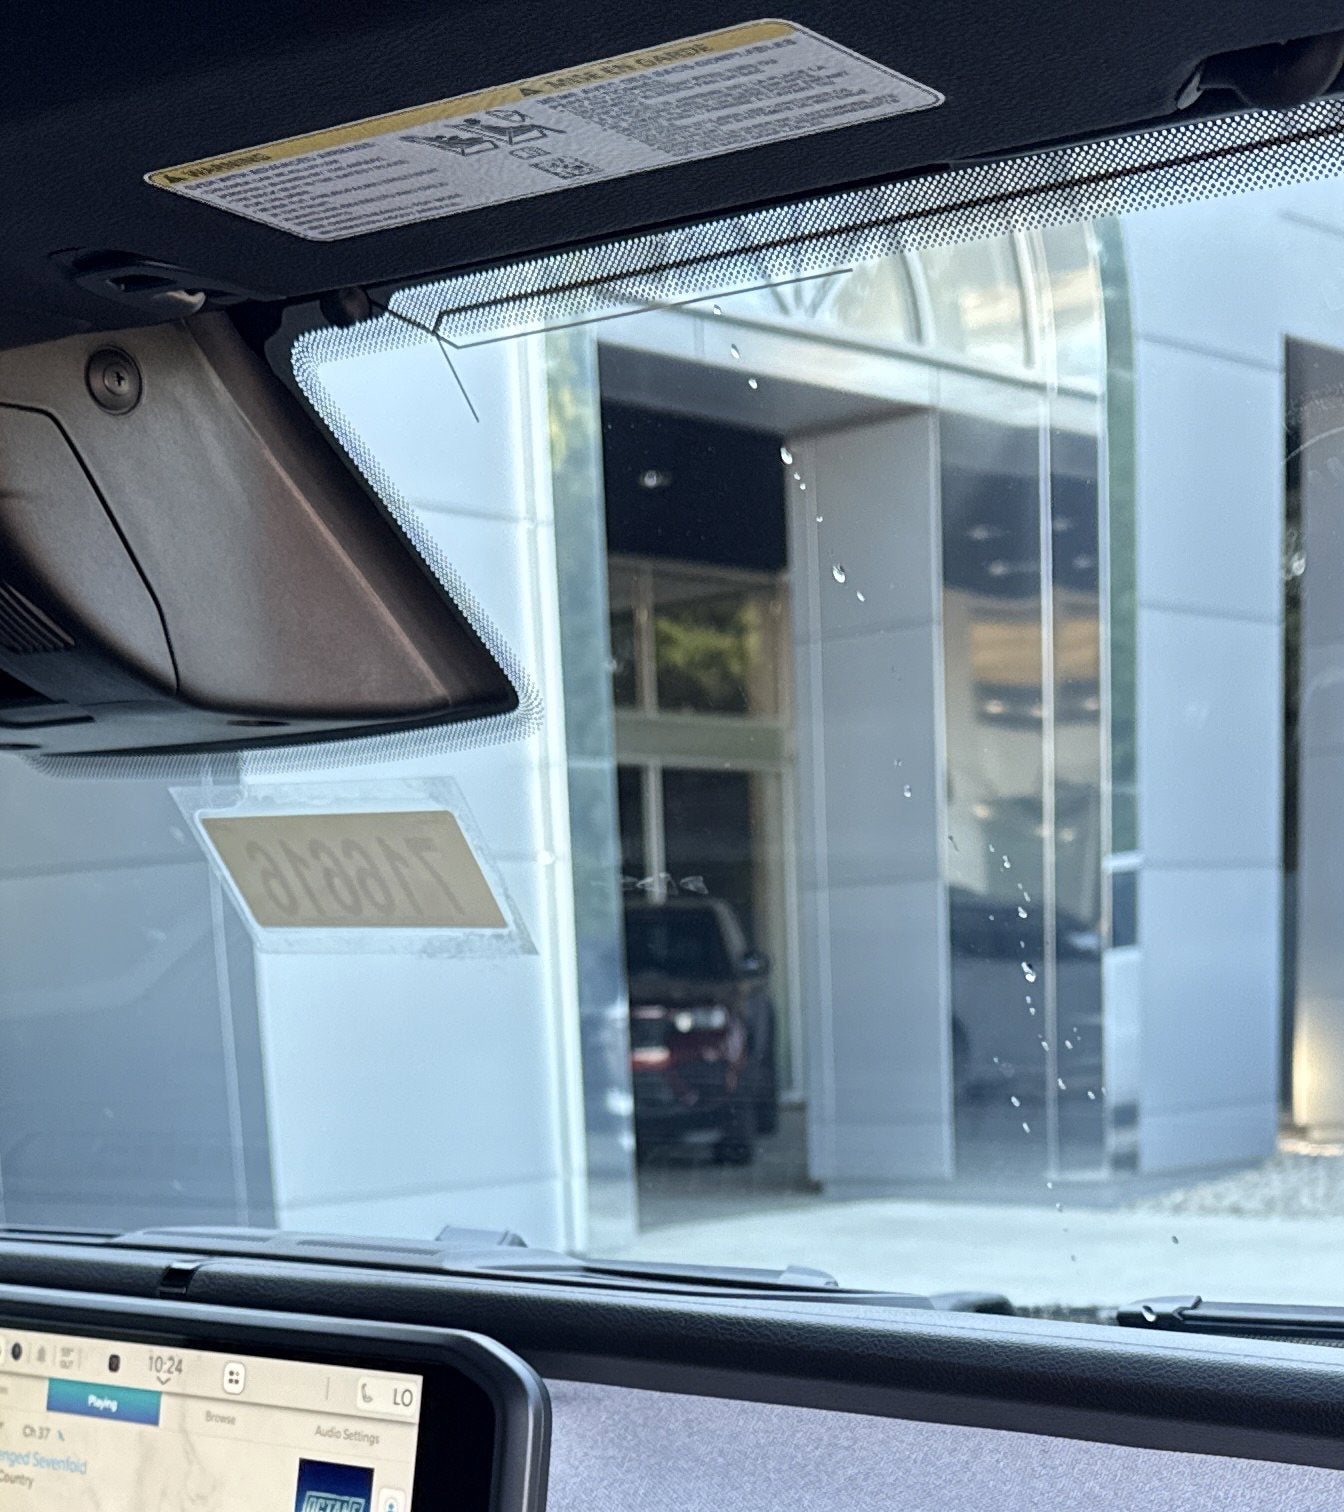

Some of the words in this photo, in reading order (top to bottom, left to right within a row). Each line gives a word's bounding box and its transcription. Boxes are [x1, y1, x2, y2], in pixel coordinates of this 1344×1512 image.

[148, 1355, 183, 1375] 10:24
[87, 1394, 118, 1413] Playing
[393, 1388, 414, 1407] LO
[205, 1410, 236, 1425] Browse
[37, 1426, 50, 1440] 37
[315, 1425, 342, 1440] Audio
[343, 1429, 380, 1446] Settings
[32, 1452, 88, 1475] Sevenfold
